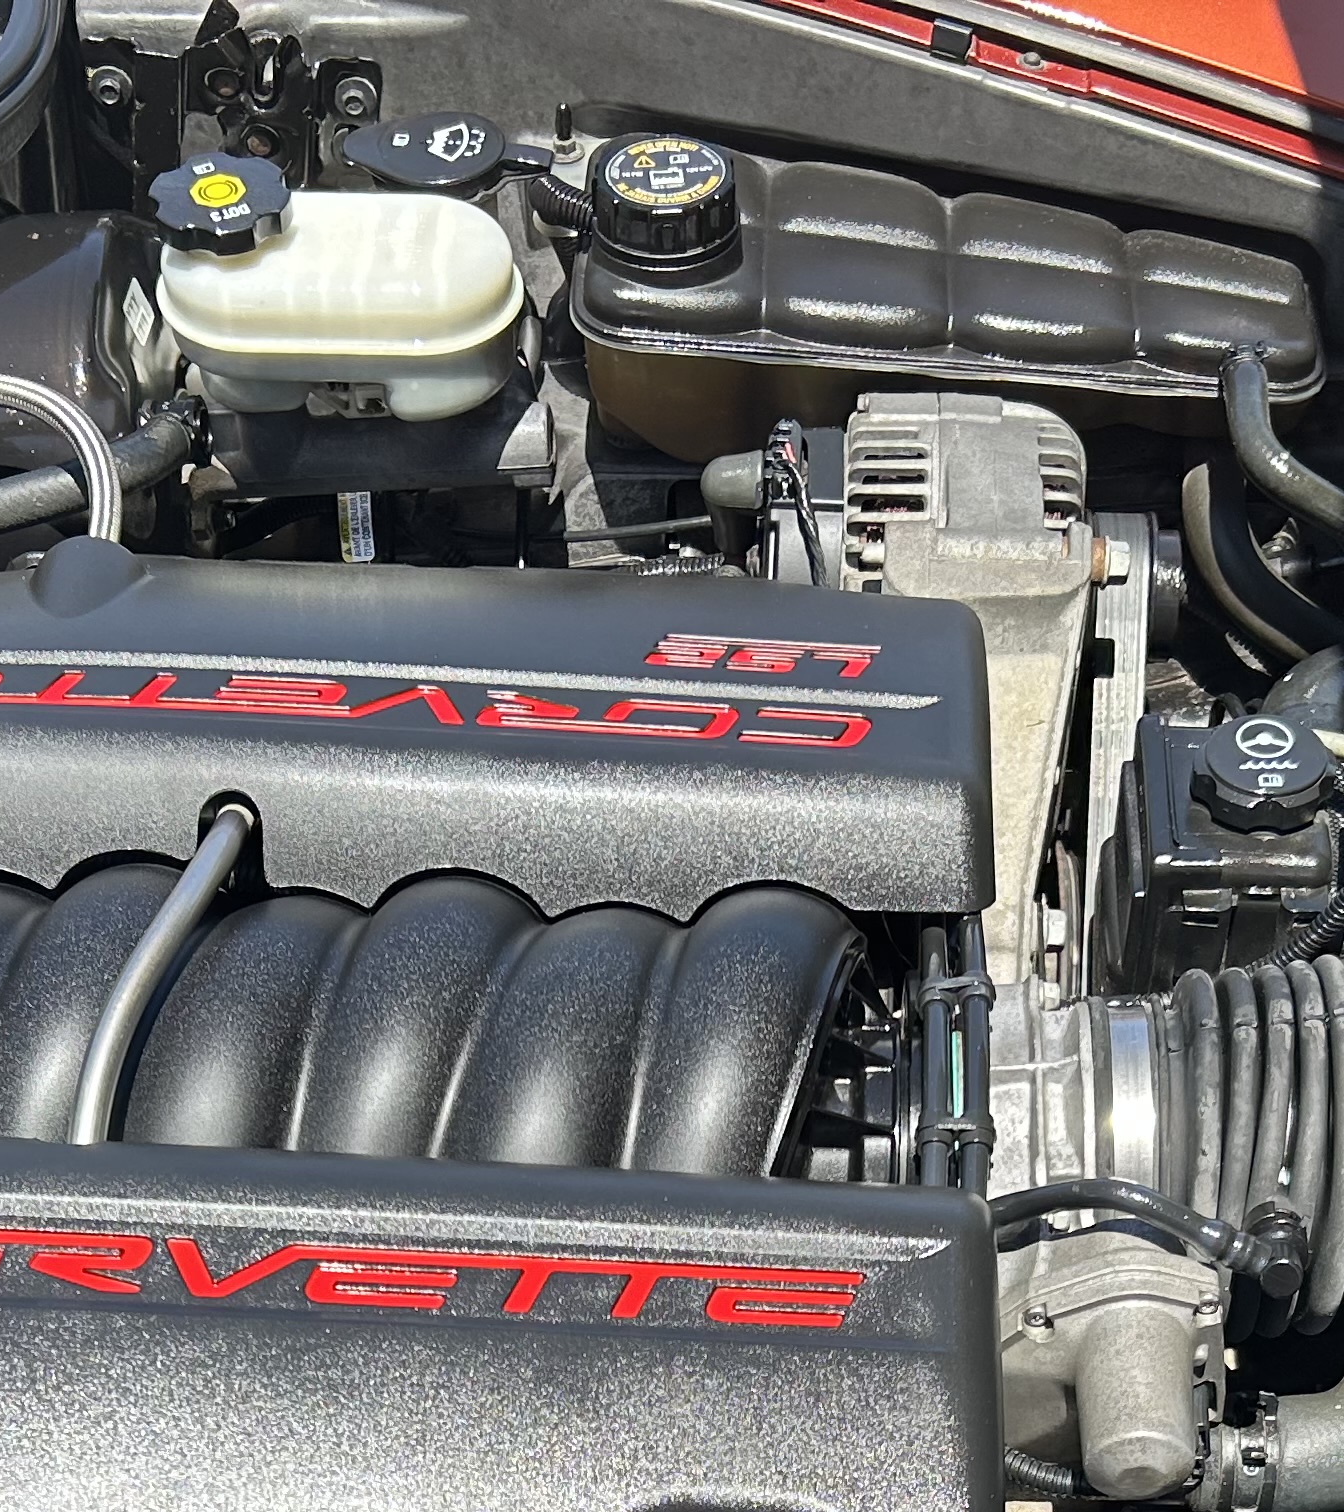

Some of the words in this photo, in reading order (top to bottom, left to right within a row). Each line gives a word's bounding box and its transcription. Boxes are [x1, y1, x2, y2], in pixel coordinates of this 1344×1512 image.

[209, 210, 222, 222] 3
[221, 202, 250, 219] DOT
[644, 636, 881, 678] LS2
